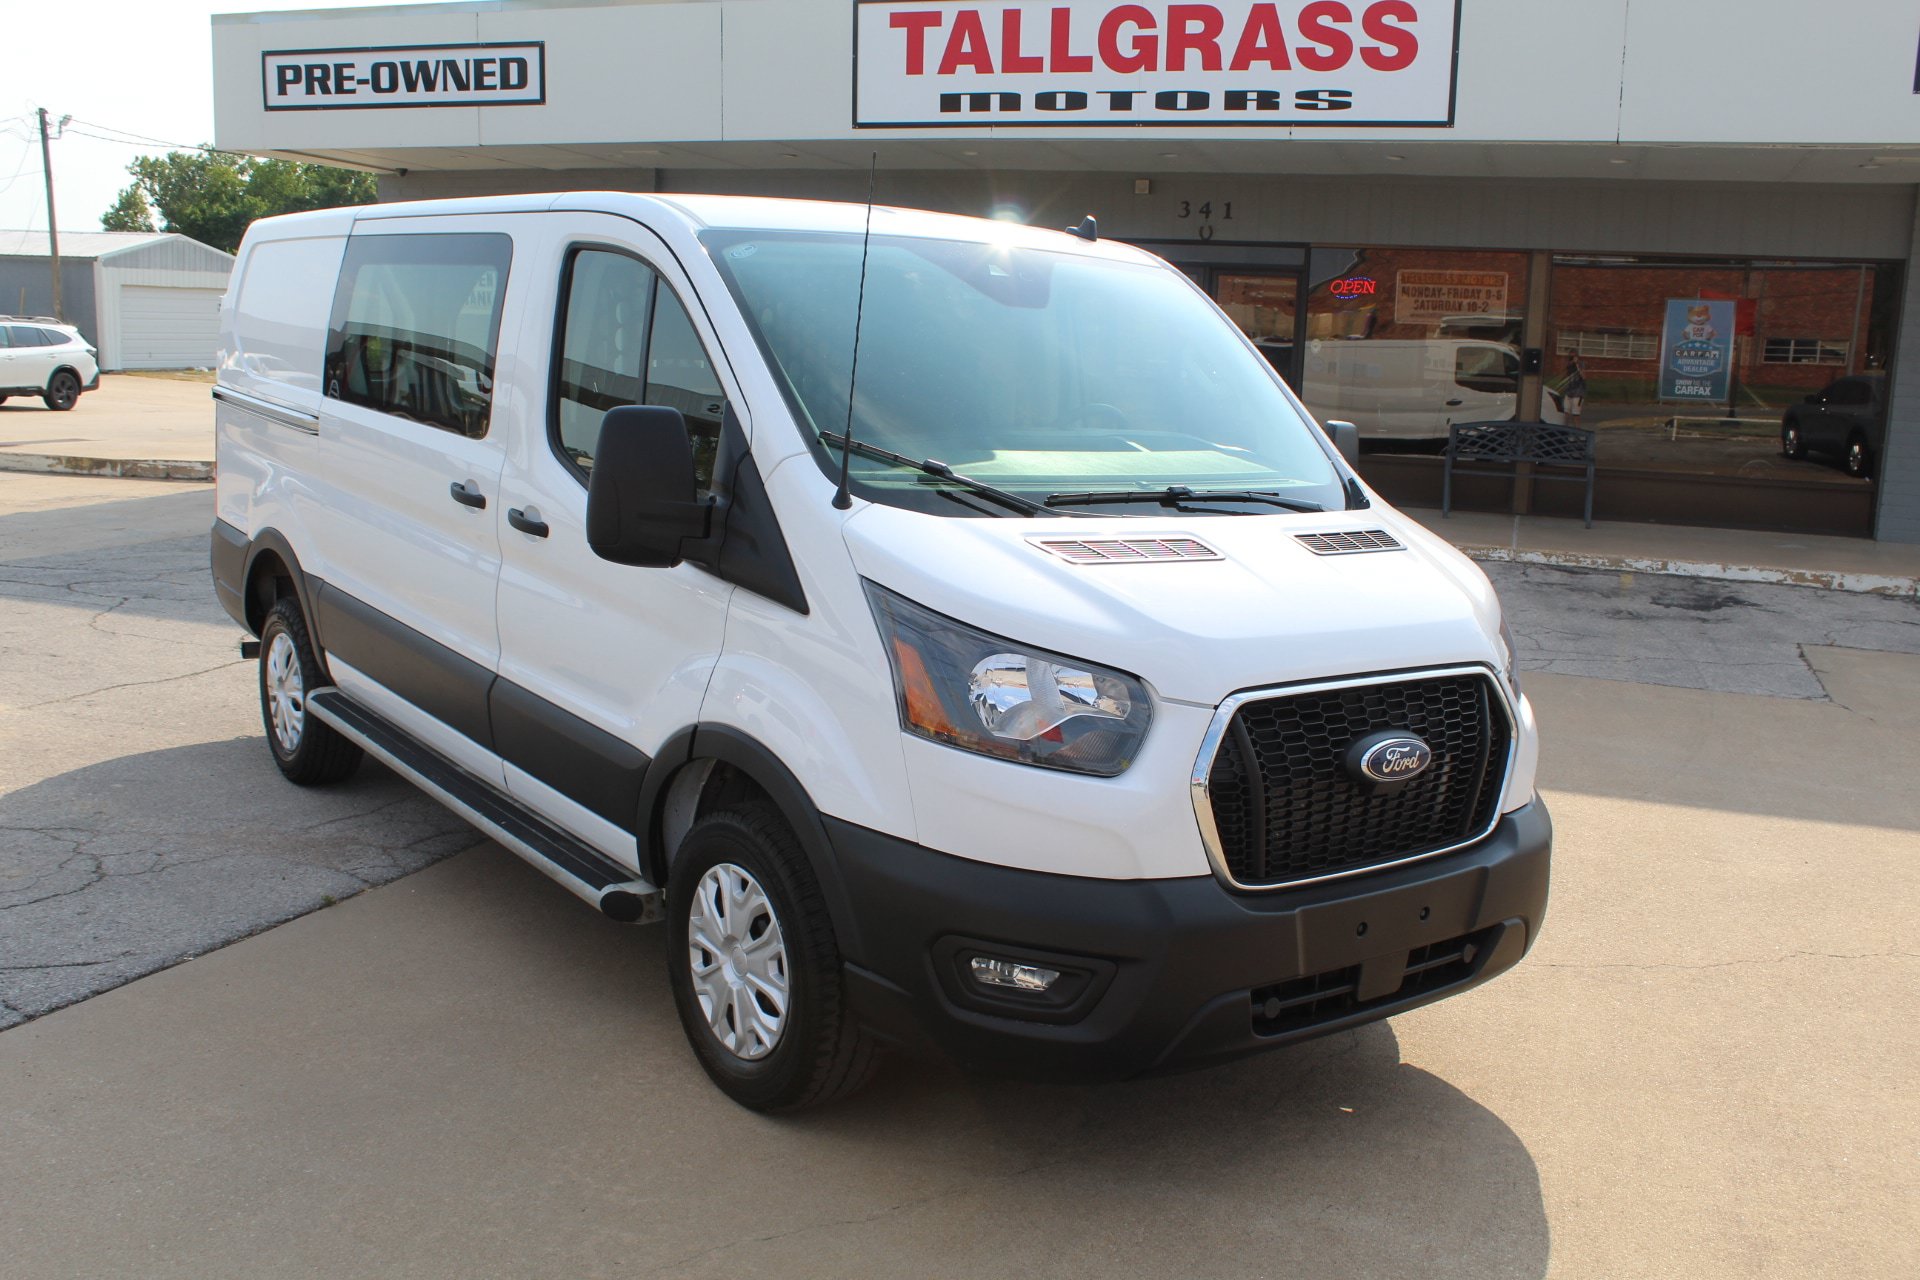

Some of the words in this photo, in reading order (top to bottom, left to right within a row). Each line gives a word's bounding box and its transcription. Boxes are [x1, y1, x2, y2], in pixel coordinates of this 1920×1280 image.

[889, 0, 1419, 76] TALLGRASS
[276, 57, 528, 96] PRE-OWNED
[939, 89, 1353, 113] MOTORS
[1178, 200, 1232, 220] 341
[1330, 279, 1377, 294] OPEN
[1401, 286, 1482, 299] MONDAY-FRIDAY
[1413, 300, 1463, 312] SATURDAY
[1675, 350, 1720, 358] CARFAX
[1675, 386, 1711, 395] CARFAX
[1382, 746, 1420, 773] Ford
